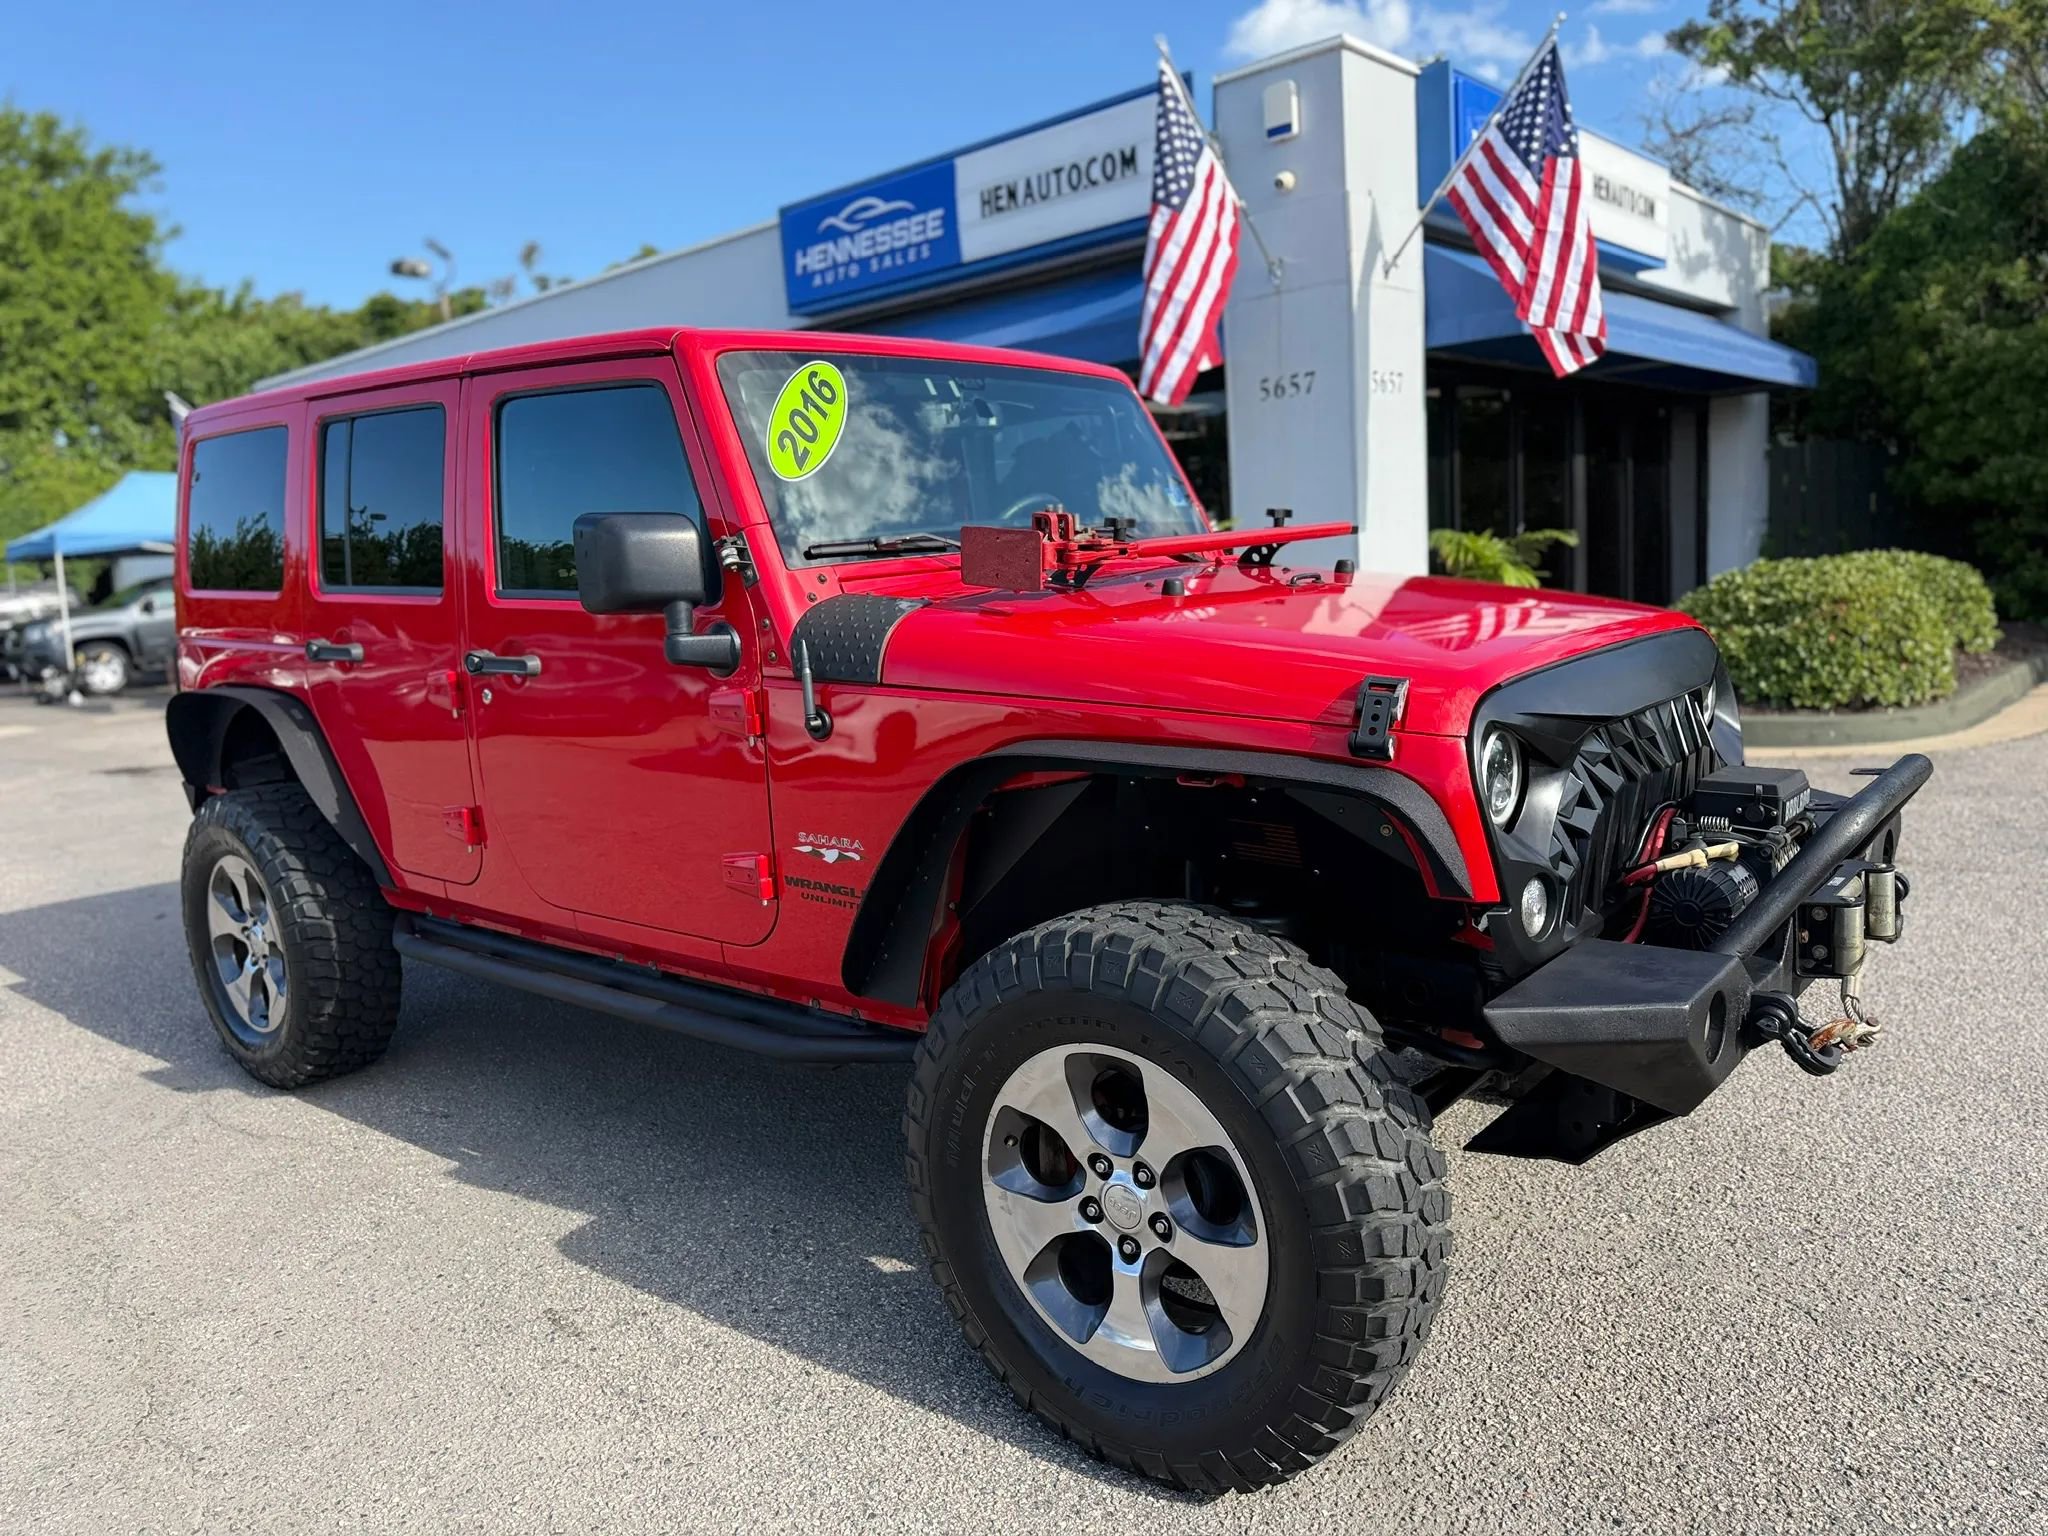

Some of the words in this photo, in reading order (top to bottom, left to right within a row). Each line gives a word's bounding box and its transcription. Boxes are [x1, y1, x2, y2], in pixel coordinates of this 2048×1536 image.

[980, 145, 1138, 218] HENAUTO.COM
[795, 207, 944, 276] HENNESSEE
[812, 262, 860, 288] AUTO
[869, 243, 930, 272] SALES
[1260, 370, 1316, 401] 5657
[1372, 370, 1402, 393] 5657
[777, 370, 837, 471] 2016
[798, 831, 864, 851] SAHARA
